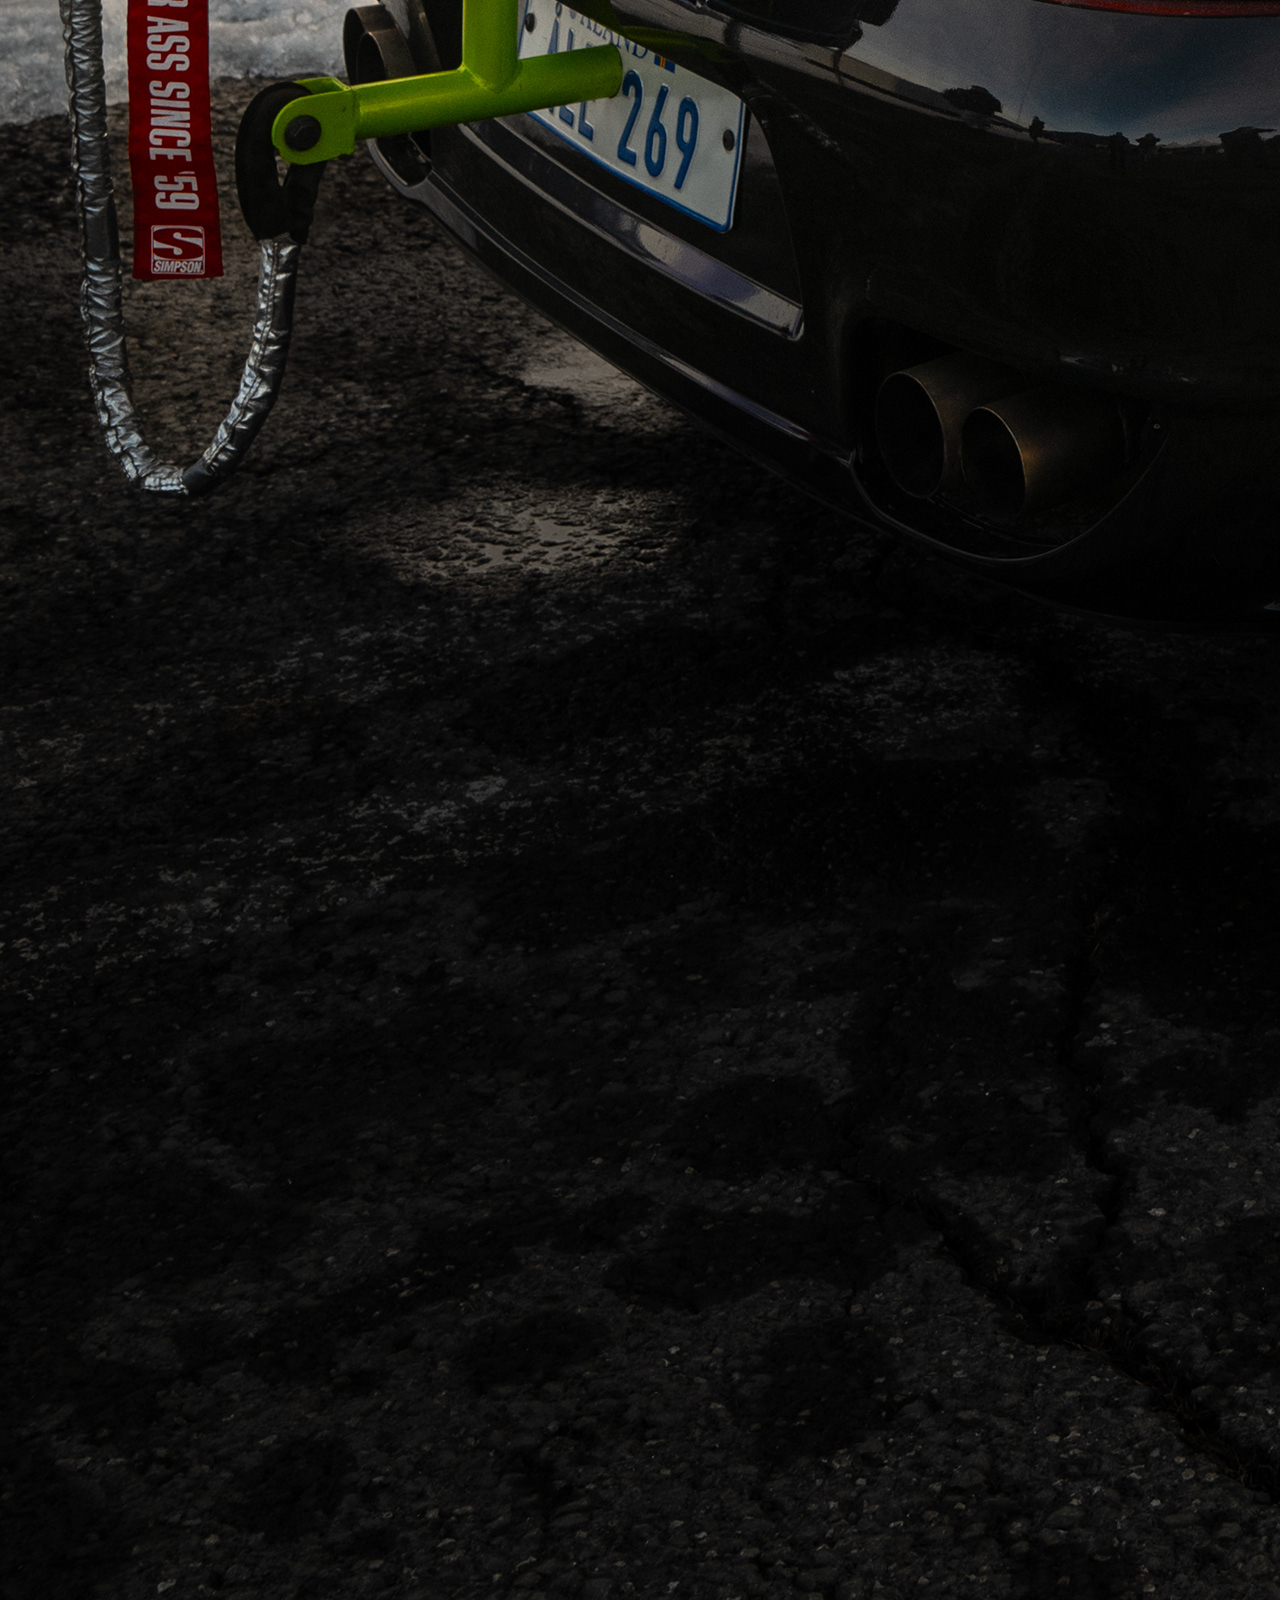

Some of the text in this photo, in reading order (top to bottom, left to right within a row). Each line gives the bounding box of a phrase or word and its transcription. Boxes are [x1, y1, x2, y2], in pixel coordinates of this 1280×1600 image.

[146, 16, 190, 71] ASS
[149, 80, 192, 162] SINCE
[617, 69, 699, 189] 269
[153, 260, 201, 273] SIMPSON
